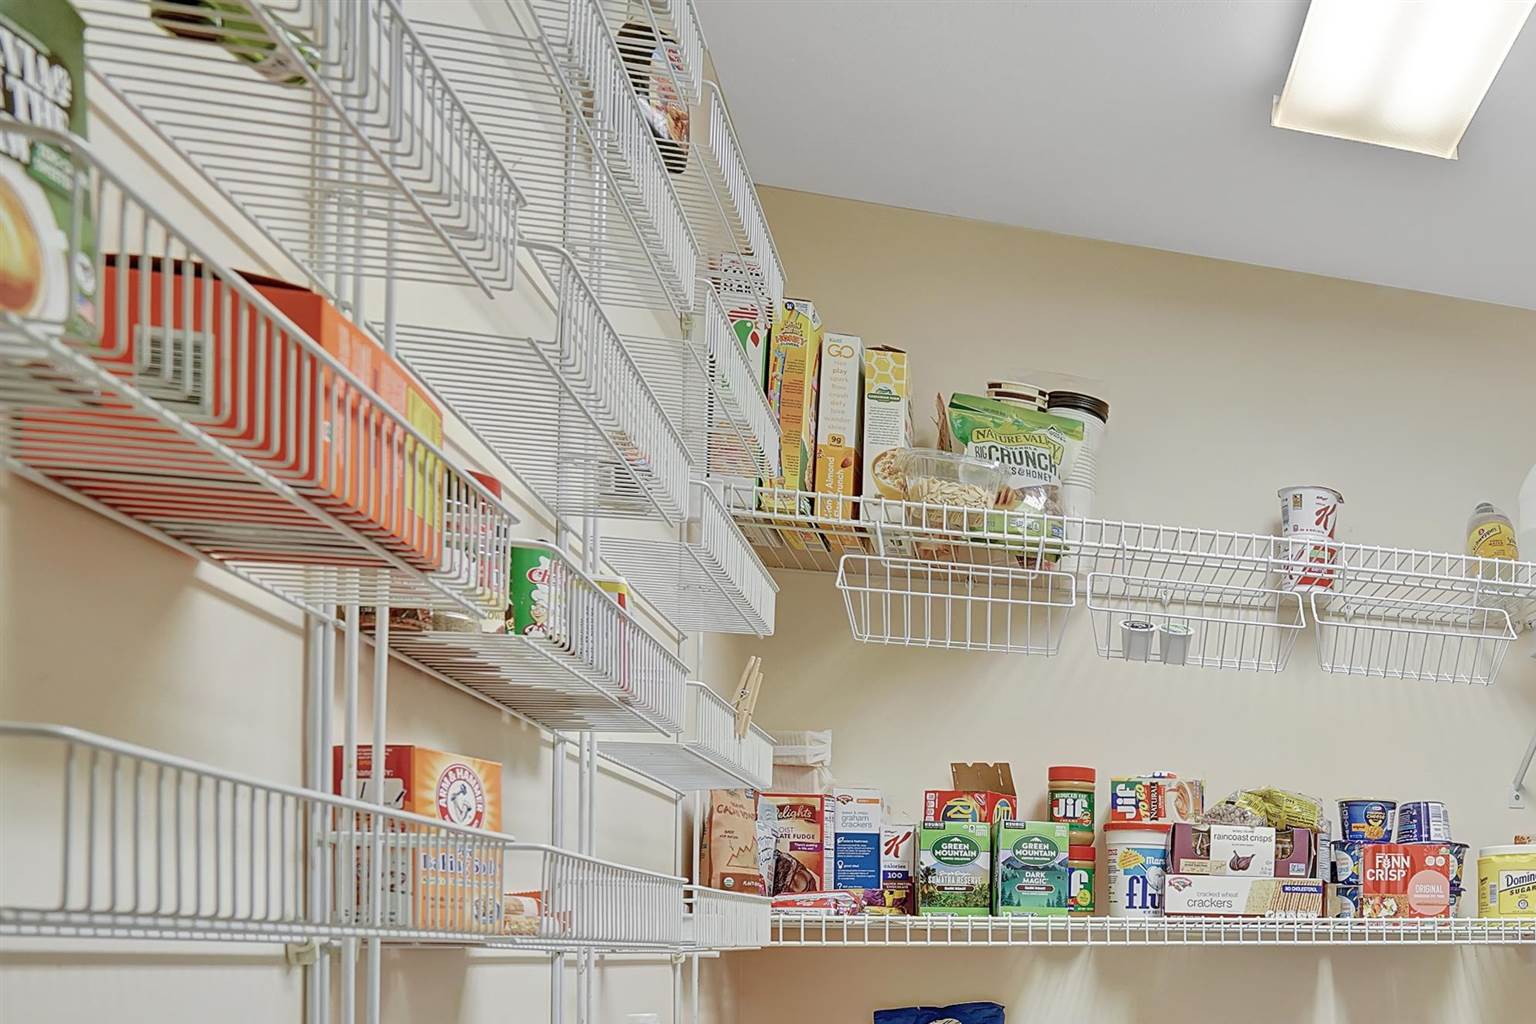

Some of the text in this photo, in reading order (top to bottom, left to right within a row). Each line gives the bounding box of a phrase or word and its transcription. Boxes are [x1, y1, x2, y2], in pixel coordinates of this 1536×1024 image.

[976, 427, 1022, 443] NATURE
[988, 444, 1057, 476] CRUNCH
[777, 803, 814, 820] elights
[841, 814, 871, 825] graham
[841, 820, 873, 829] crackers
[1213, 832, 1273, 843] raincoast crisps
[941, 842, 970, 852] GREEN
[1021, 842, 1051, 852] GREEN
[934, 849, 978, 859] MOUNTAIN
[1015, 849, 1059, 859] MOUNTAIN
[887, 872, 903, 880] 100
[1025, 871, 1046, 879] DARK
[1366, 868, 1407, 881] CRISP
[1022, 877, 1047, 886] MAGIC
[1415, 884, 1443, 893] ORIGINAL
[1187, 897, 1233, 909] crackers
